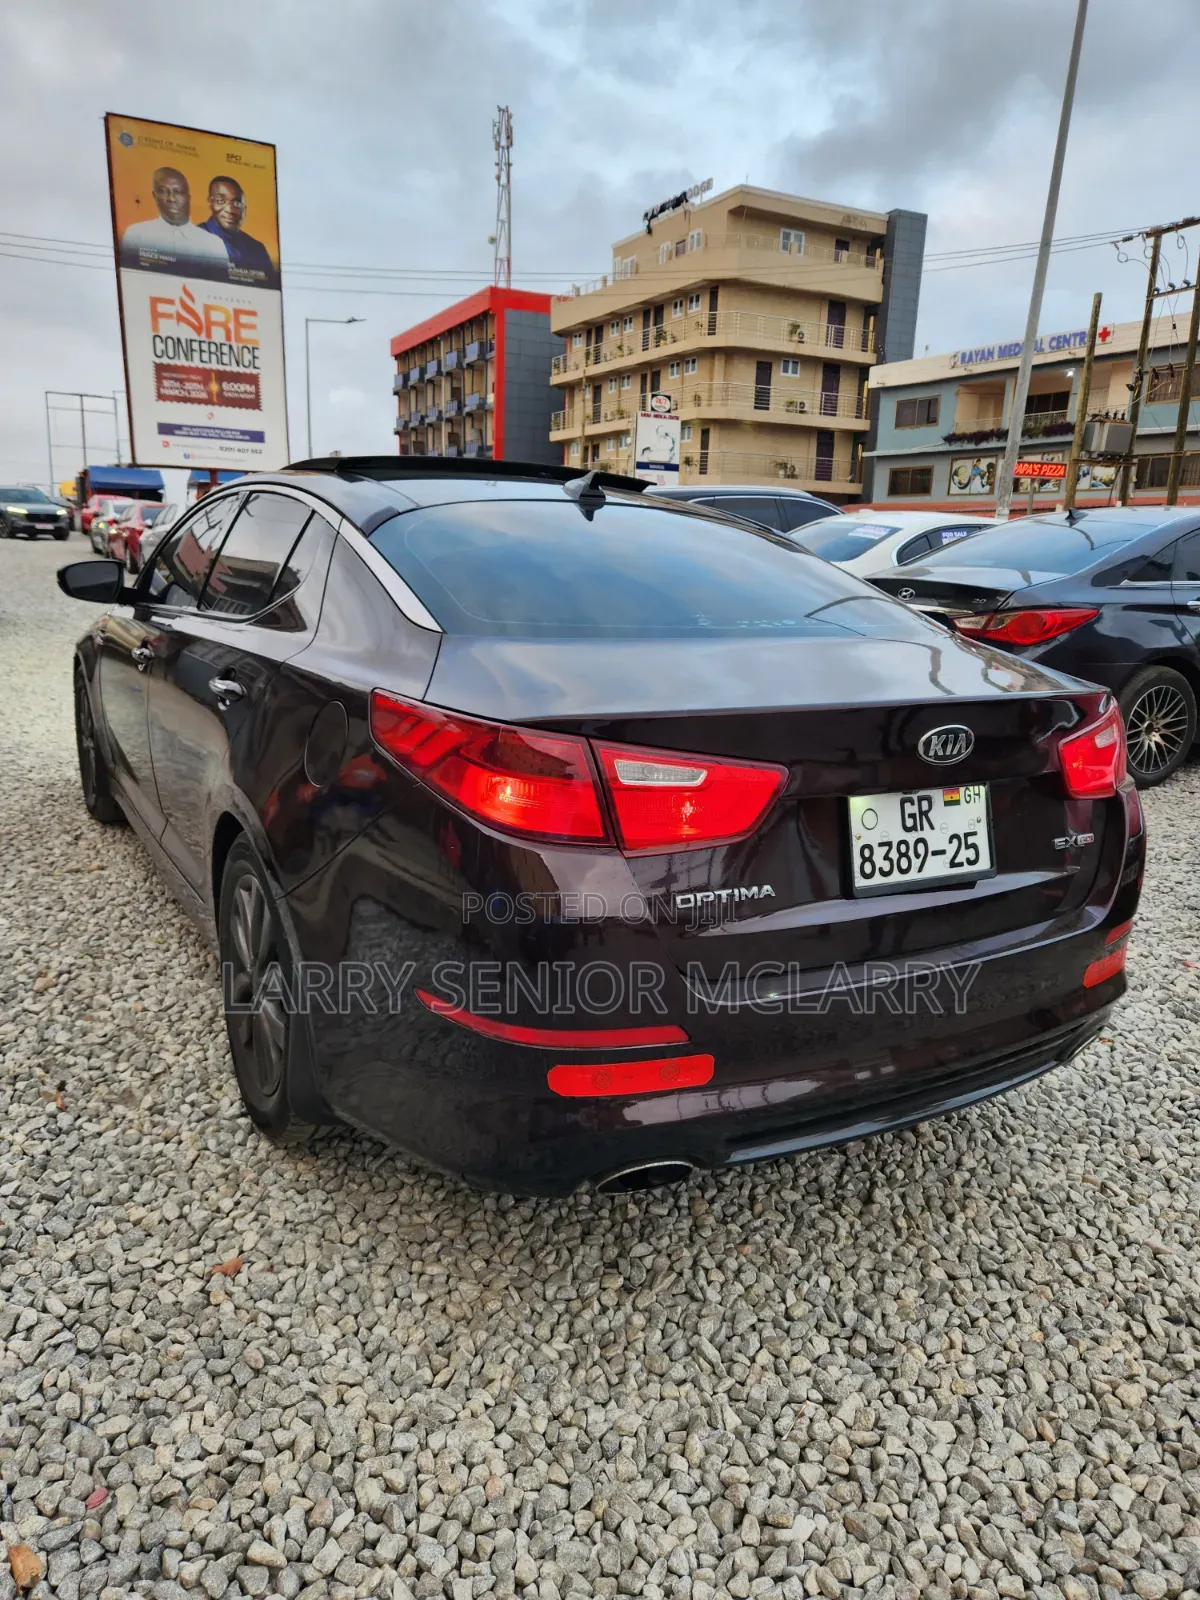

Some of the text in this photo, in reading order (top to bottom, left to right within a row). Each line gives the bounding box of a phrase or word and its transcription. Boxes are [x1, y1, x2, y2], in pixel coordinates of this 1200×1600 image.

[152, 334, 261, 370] CONFERENCE
[960, 331, 1087, 365] RAYAN MEDAL CENTR
[1041, 464, 1065, 476] PIZZA
[928, 733, 967, 758] KIA
[900, 785, 981, 833] GR GH
[859, 831, 980, 880] 8389-25
[1053, 835, 1077, 850] EX
[675, 884, 777, 909] OPTIMA
